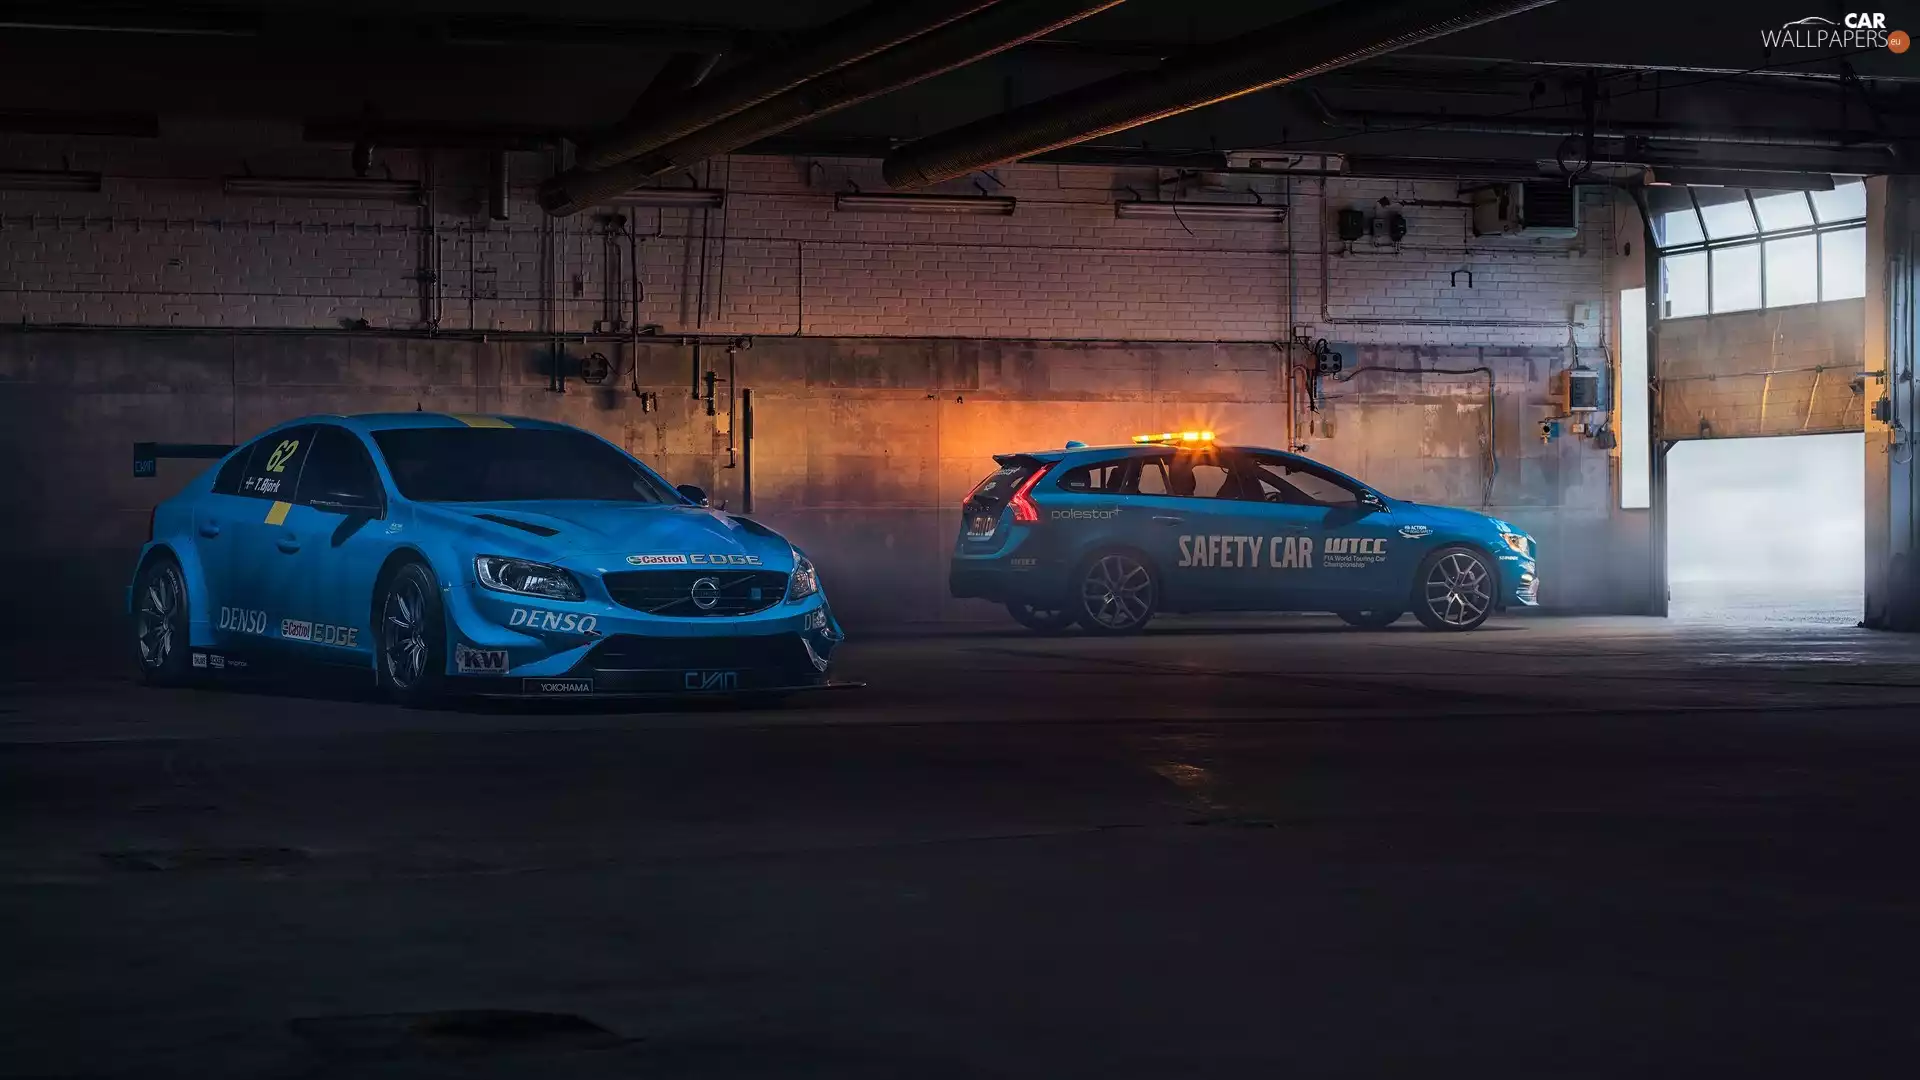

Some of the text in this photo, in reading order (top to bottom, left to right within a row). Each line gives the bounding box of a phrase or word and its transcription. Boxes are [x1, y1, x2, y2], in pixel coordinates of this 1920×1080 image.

[266, 439, 299, 473] 62
[1051, 508, 1112, 520] polestar
[1178, 534, 1314, 569] SAFETY CAR
[1324, 537, 1388, 555] WTCC
[643, 554, 764, 566] Castrol EDGE
[219, 606, 267, 634] DENSO
[288, 621, 359, 648] Castrol EDGE
[464, 651, 506, 668] KW
[540, 682, 590, 692] YOKOHAMA
